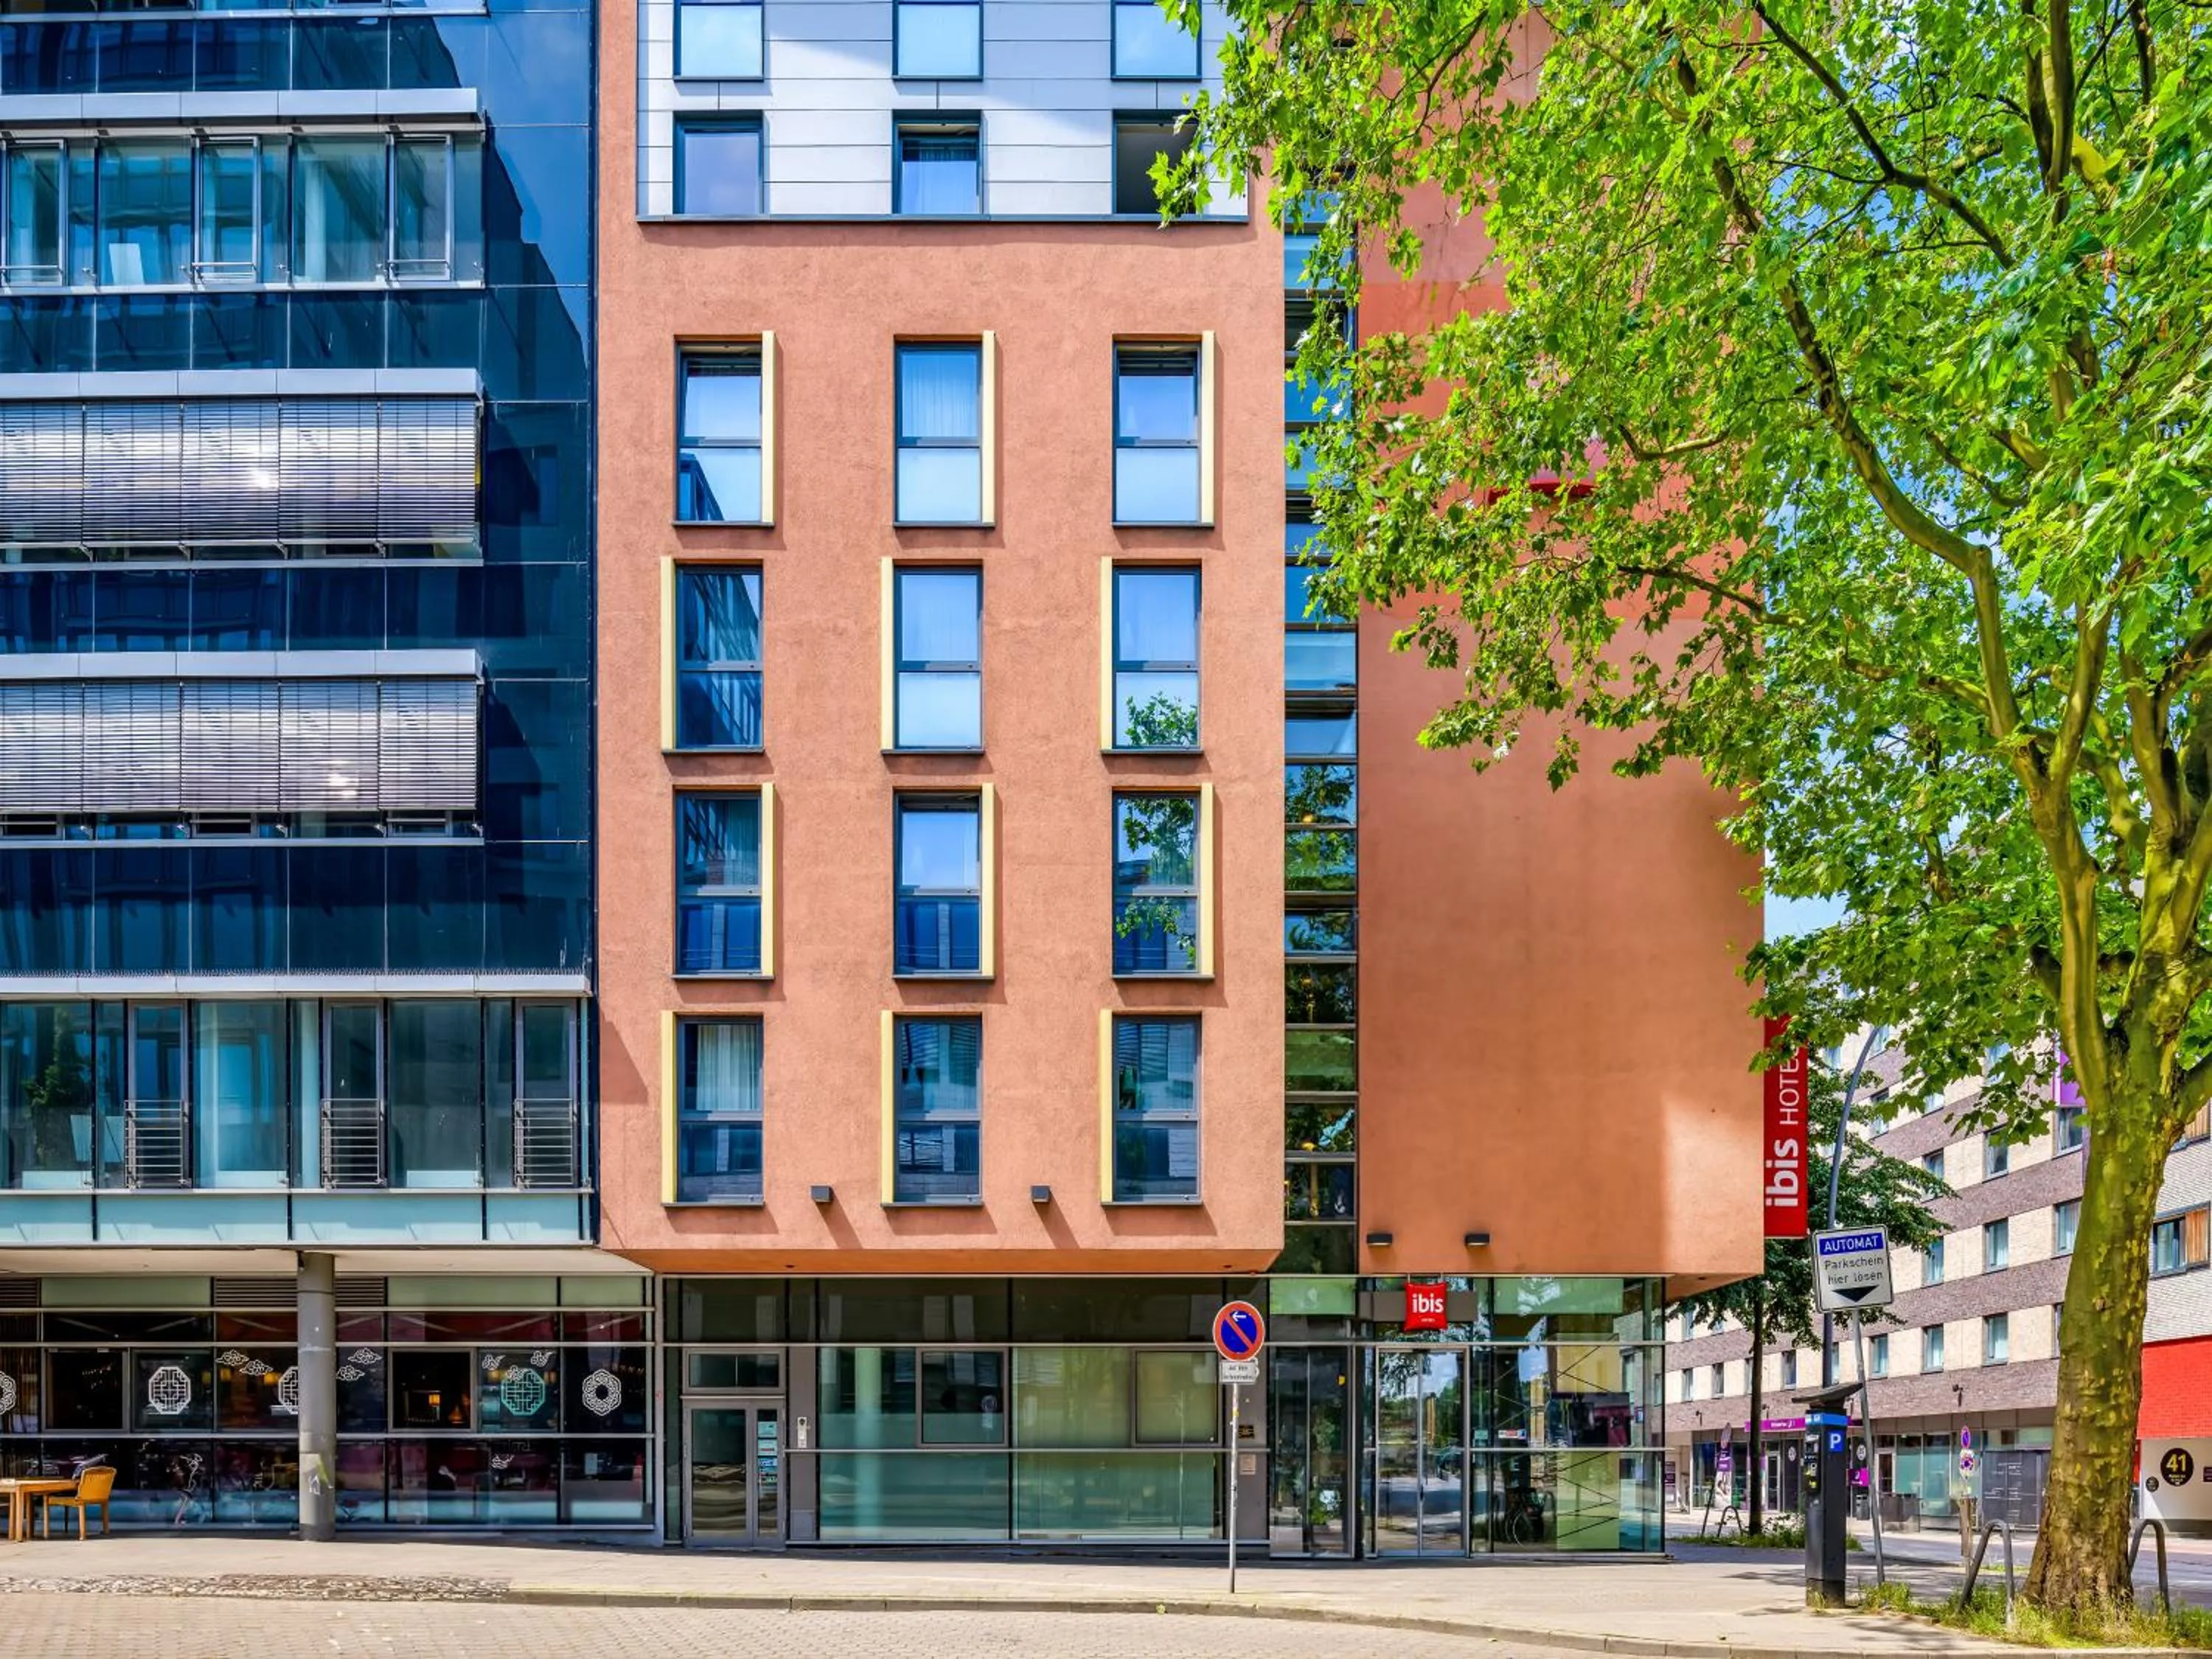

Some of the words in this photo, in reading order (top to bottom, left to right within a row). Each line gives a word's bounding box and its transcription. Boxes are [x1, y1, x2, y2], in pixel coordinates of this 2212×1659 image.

[1765, 1138, 1799, 1207] ibis
[1823, 1235, 1879, 1253] AUTOMAT
[1824, 1255, 1884, 1270] Parkschein
[1828, 1275, 1848, 1284] hier
[1412, 1293, 1444, 1313] ibis
[1829, 1433, 1841, 1450] P
[2166, 1453, 2186, 1472] 41
